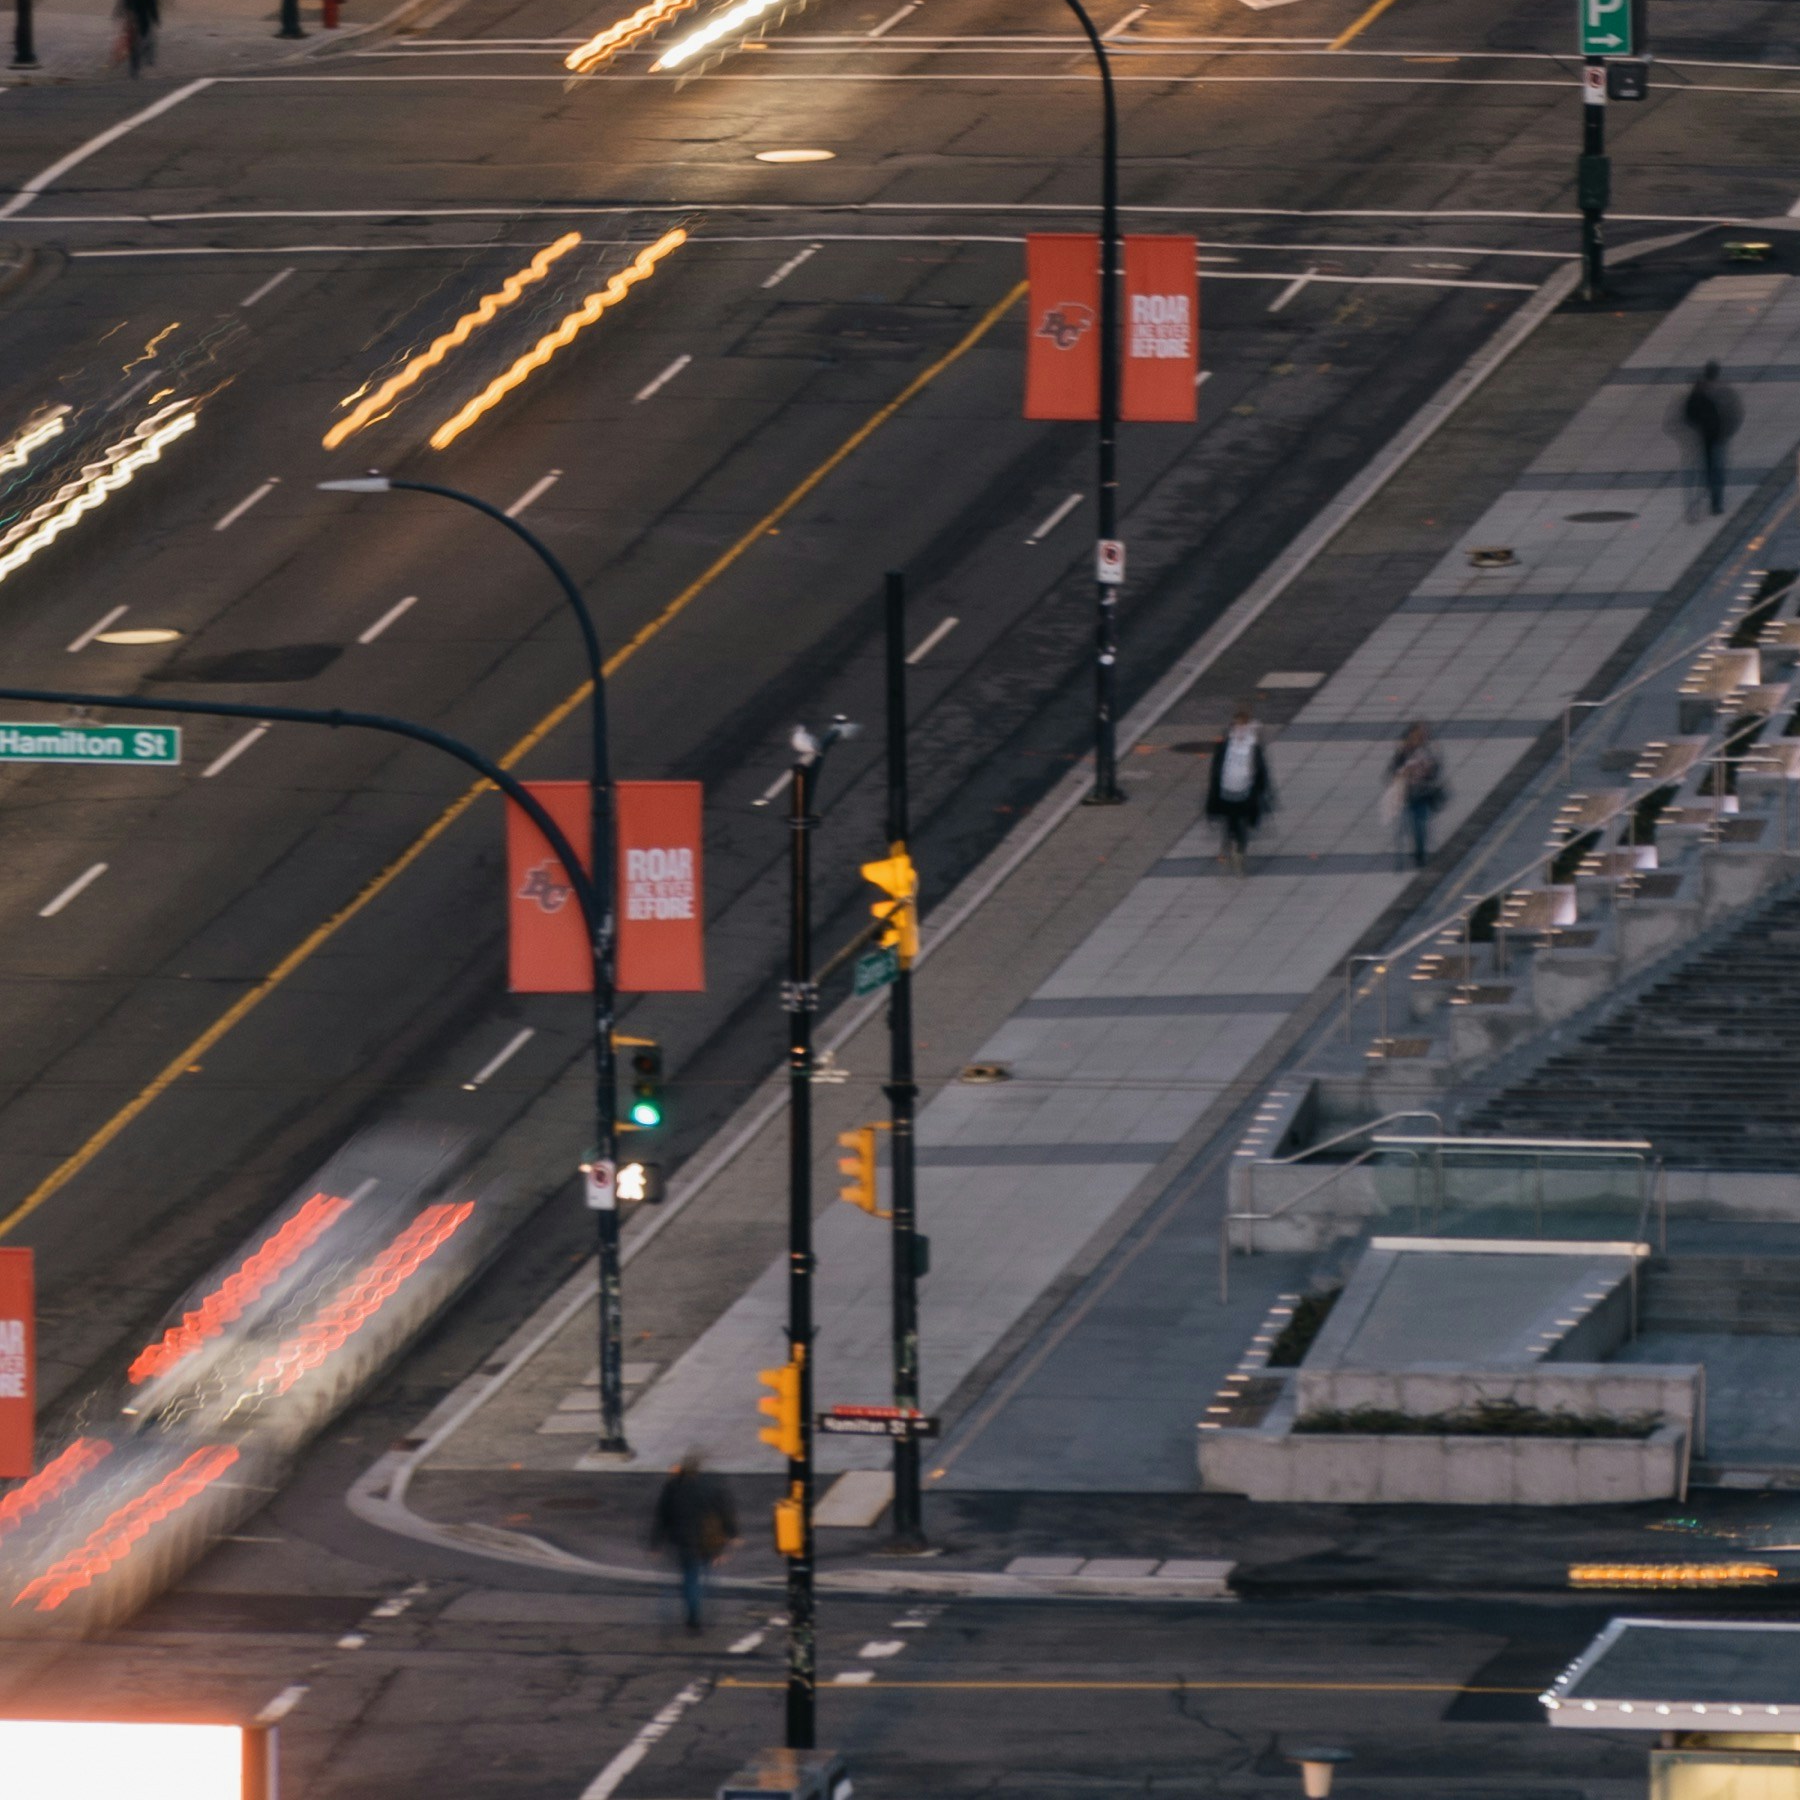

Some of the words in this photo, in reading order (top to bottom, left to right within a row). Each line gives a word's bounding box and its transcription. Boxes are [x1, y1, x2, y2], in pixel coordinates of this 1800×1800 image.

[1131, 294, 1190, 325] ROAR
[0, 729, 123, 756] Hamilton
[133, 731, 168, 758] St
[627, 848, 693, 881] ROAR
